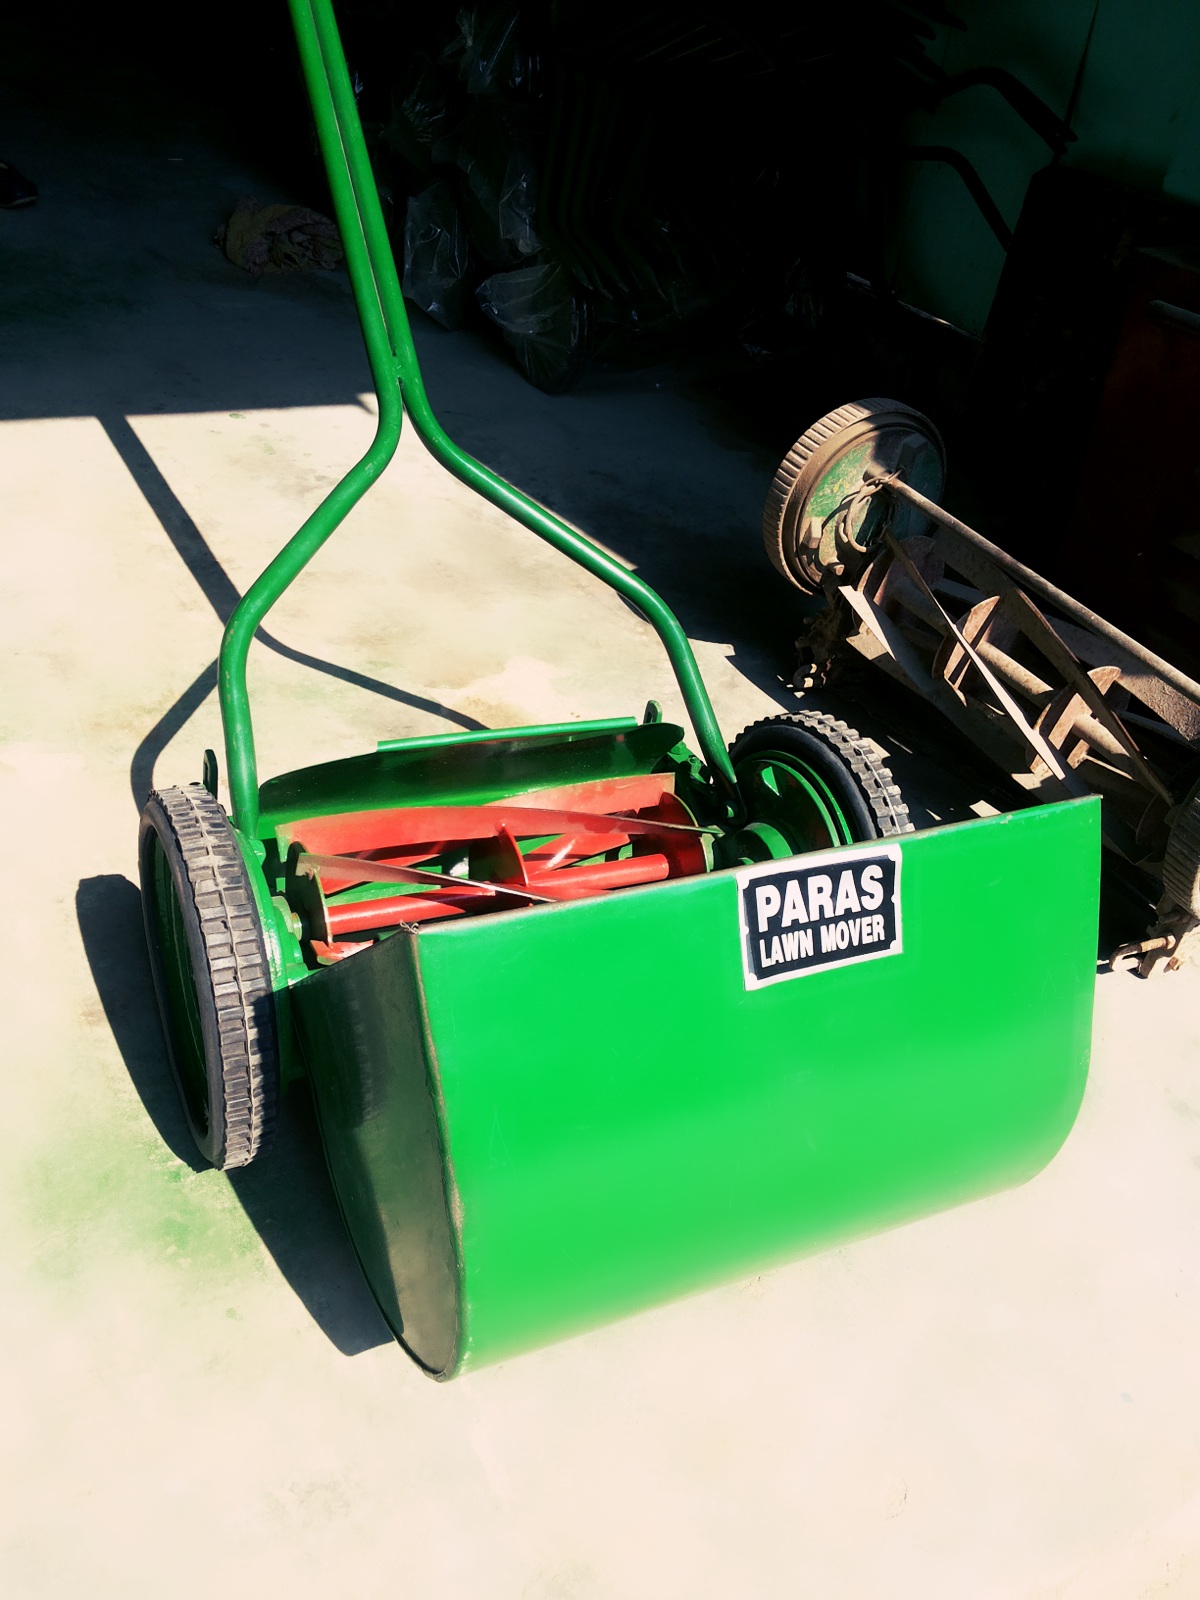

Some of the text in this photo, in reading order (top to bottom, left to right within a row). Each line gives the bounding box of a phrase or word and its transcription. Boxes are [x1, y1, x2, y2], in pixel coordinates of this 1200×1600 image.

[755, 864, 884, 933] PARAS
[759, 914, 885, 968] LAWN MOVER
